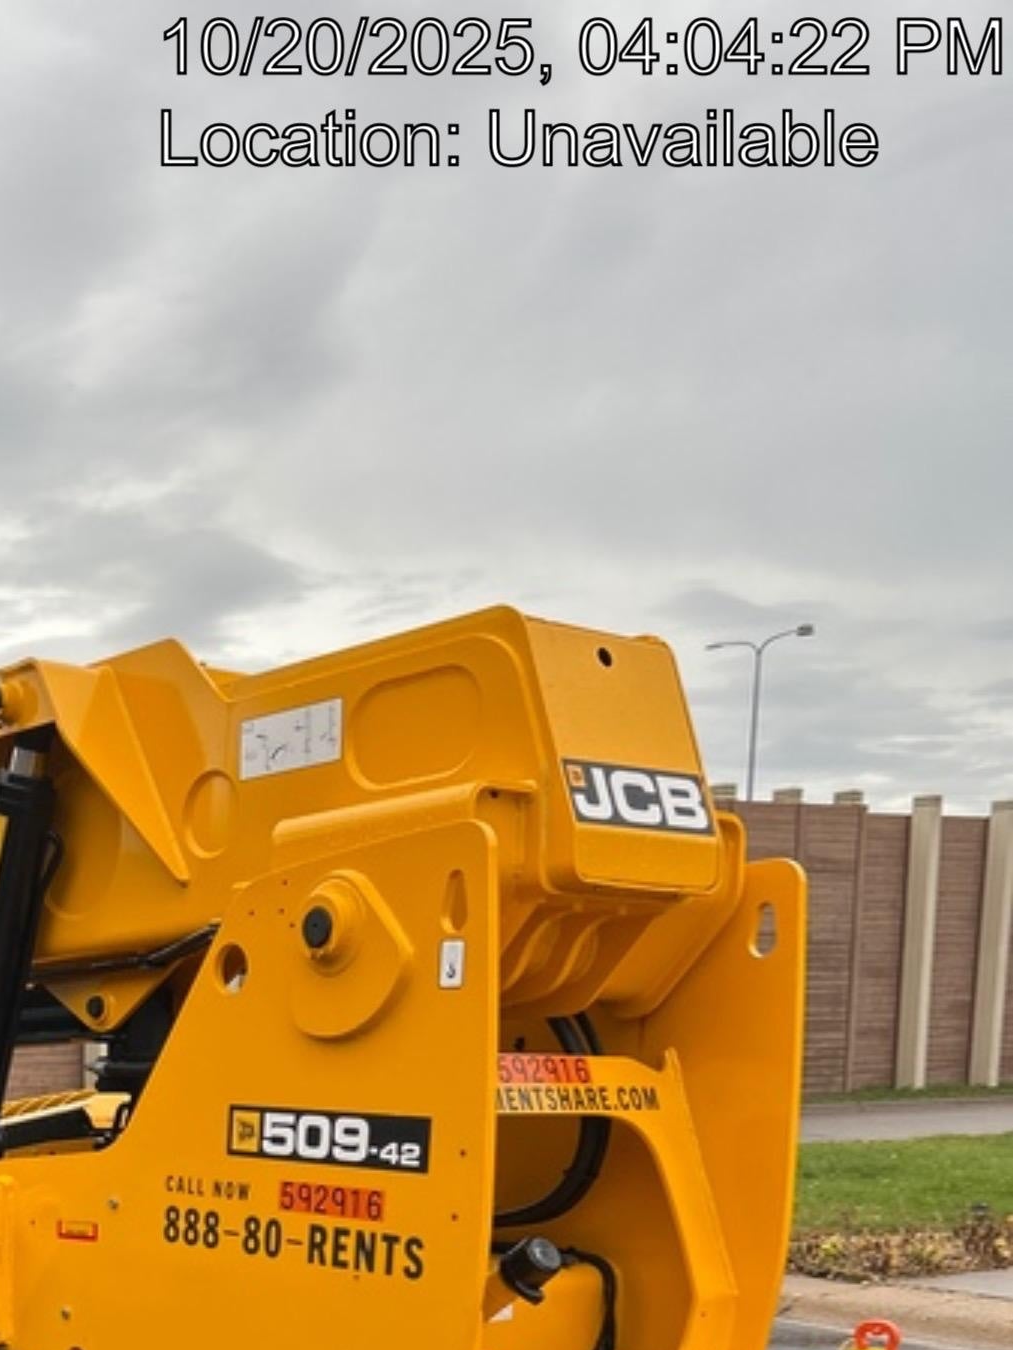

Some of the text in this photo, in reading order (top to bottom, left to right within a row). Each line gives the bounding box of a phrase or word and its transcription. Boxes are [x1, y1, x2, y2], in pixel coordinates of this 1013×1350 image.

[574, 766, 709, 830] JCB
[499, 1057, 590, 1084] 592916
[262, 1111, 420, 1168] 509-42
[165, 1175, 251, 1201] CALL NOW
[280, 1181, 383, 1221] 592916
[163, 1205, 424, 1280] 888-80-RENTS
